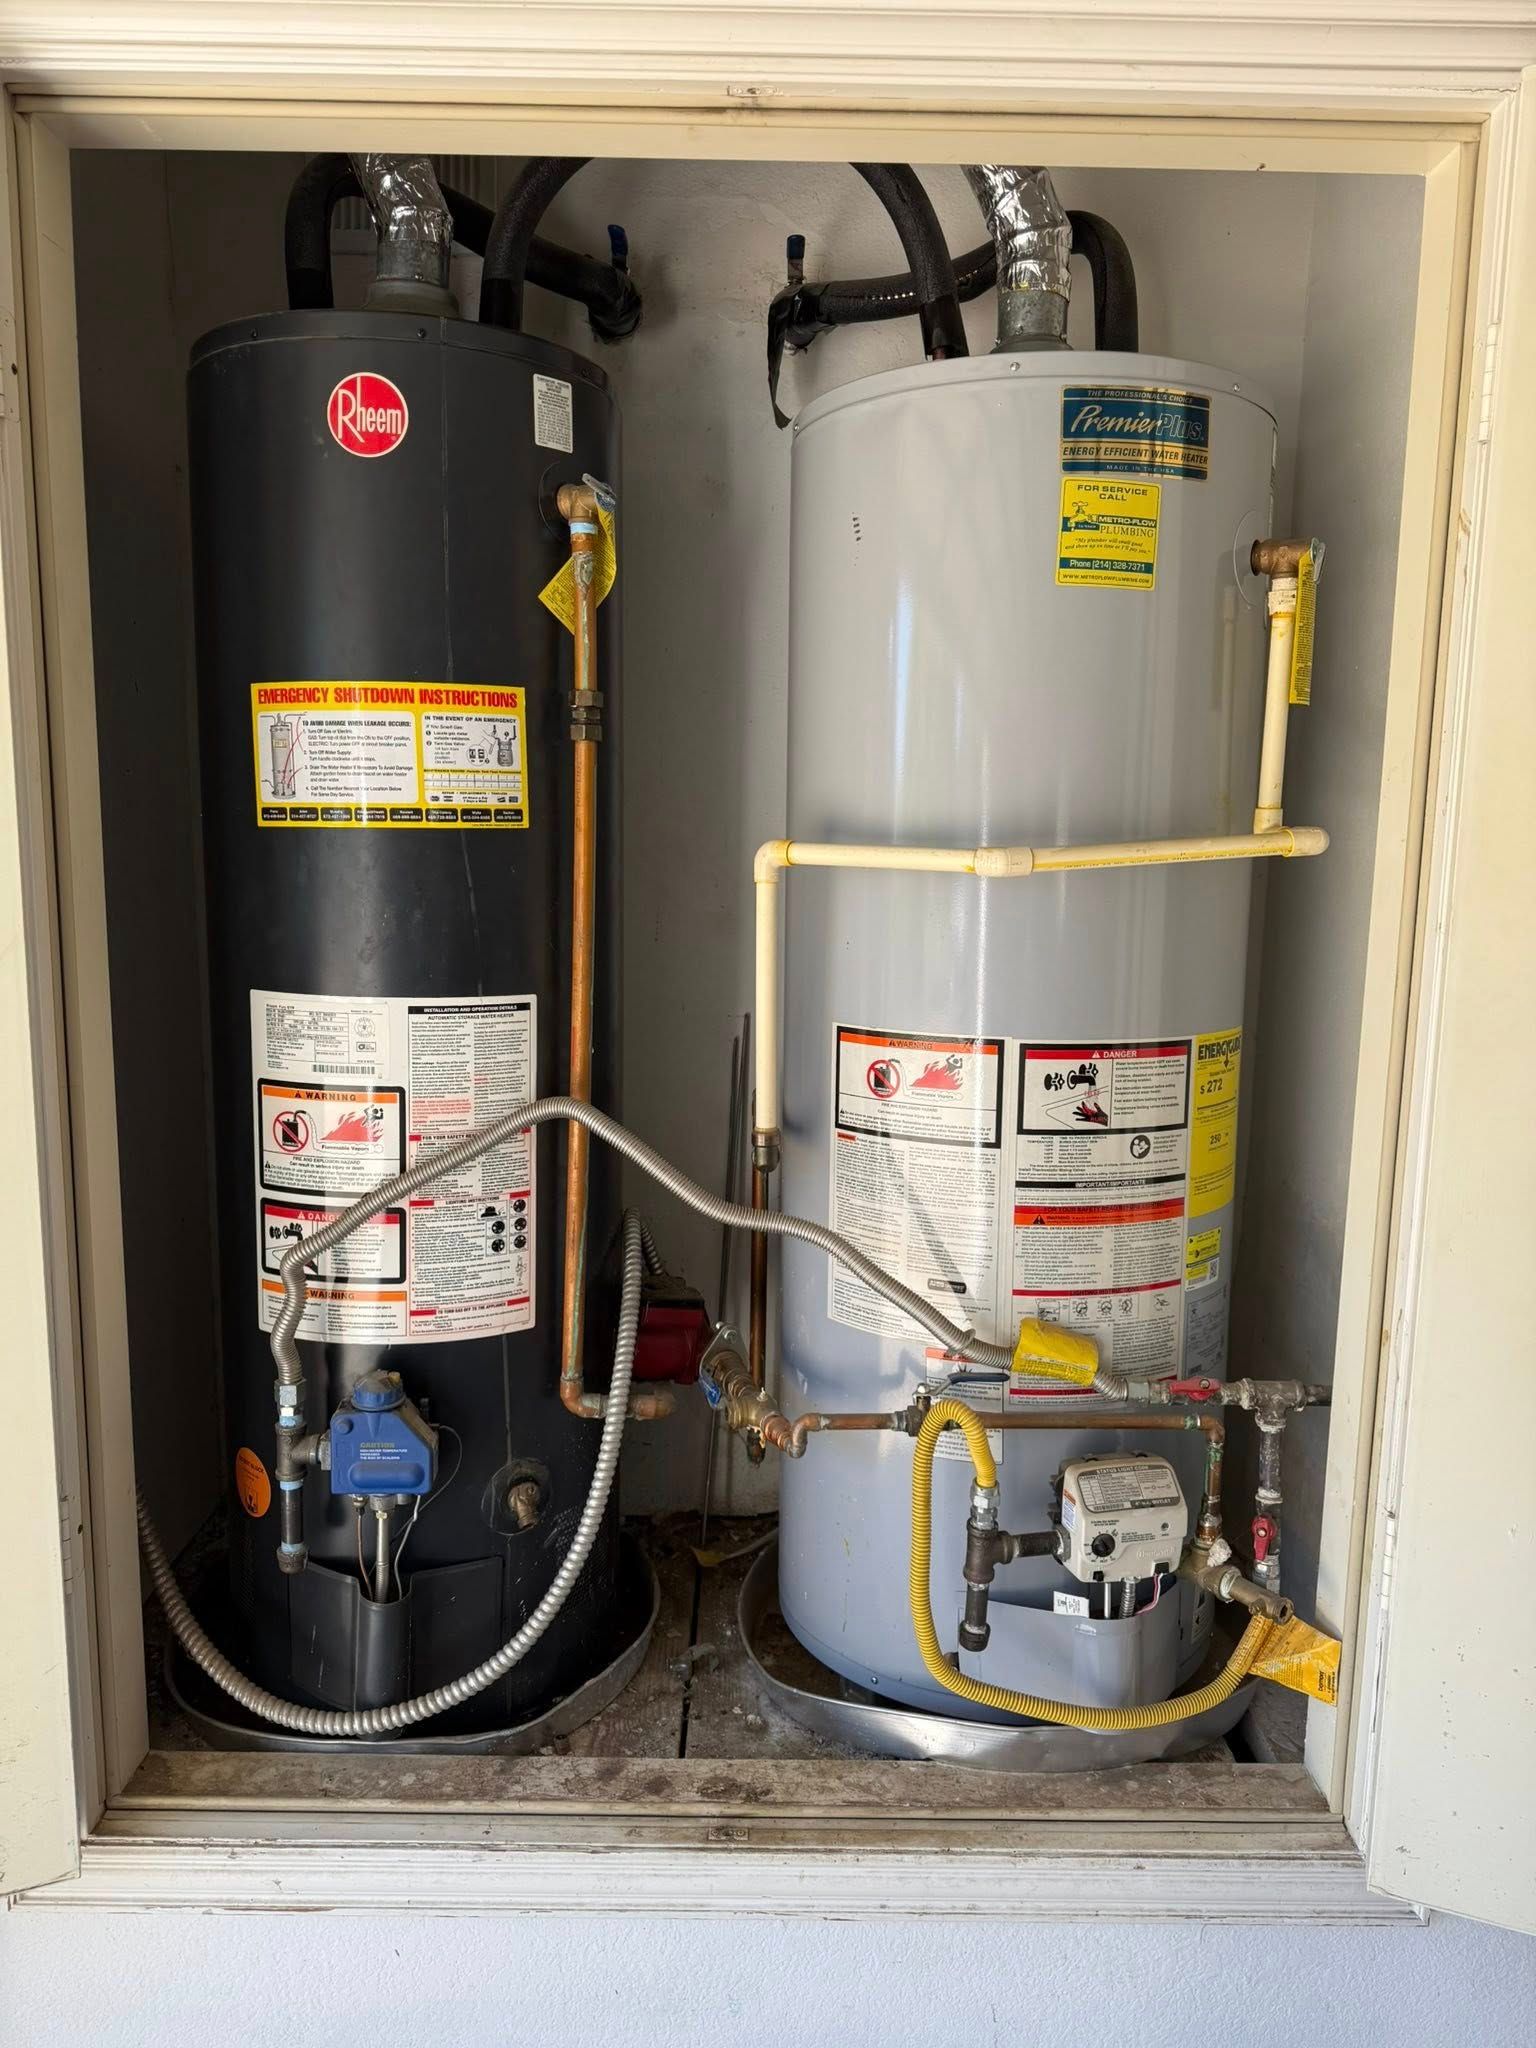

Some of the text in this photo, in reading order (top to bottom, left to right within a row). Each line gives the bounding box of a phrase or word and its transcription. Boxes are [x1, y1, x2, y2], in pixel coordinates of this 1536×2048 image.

[1104, 390, 1167, 400] PROFESSIONAL'S
[1169, 395, 1193, 404] CHOICE
[338, 376, 402, 443] Rheem
[1063, 446, 1208, 465] ENERGY EFFICIENT WATER HEATER
[1102, 485, 1148, 496] SERVICE
[1099, 493, 1127, 501] CALL
[1099, 516, 1156, 527] METRO-FLOW
[1100, 525, 1154, 538] PLUMBING
[1070, 559, 1144, 571] Phone (214) 328-7371
[258, 687, 517, 708] EMERGENCY SHUTDOWN INSTRUCTIONS
[896, 1040, 933, 1050] WARNING
[1103, 1050, 1137, 1059] DANGER
[1207, 1078, 1223, 1094] 272
[305, 1092, 356, 1102] WARNING
[1103, 1204, 1117, 1212] READ
[308, 1214, 340, 1222] DANG
[310, 1290, 355, 1299] WARNING
